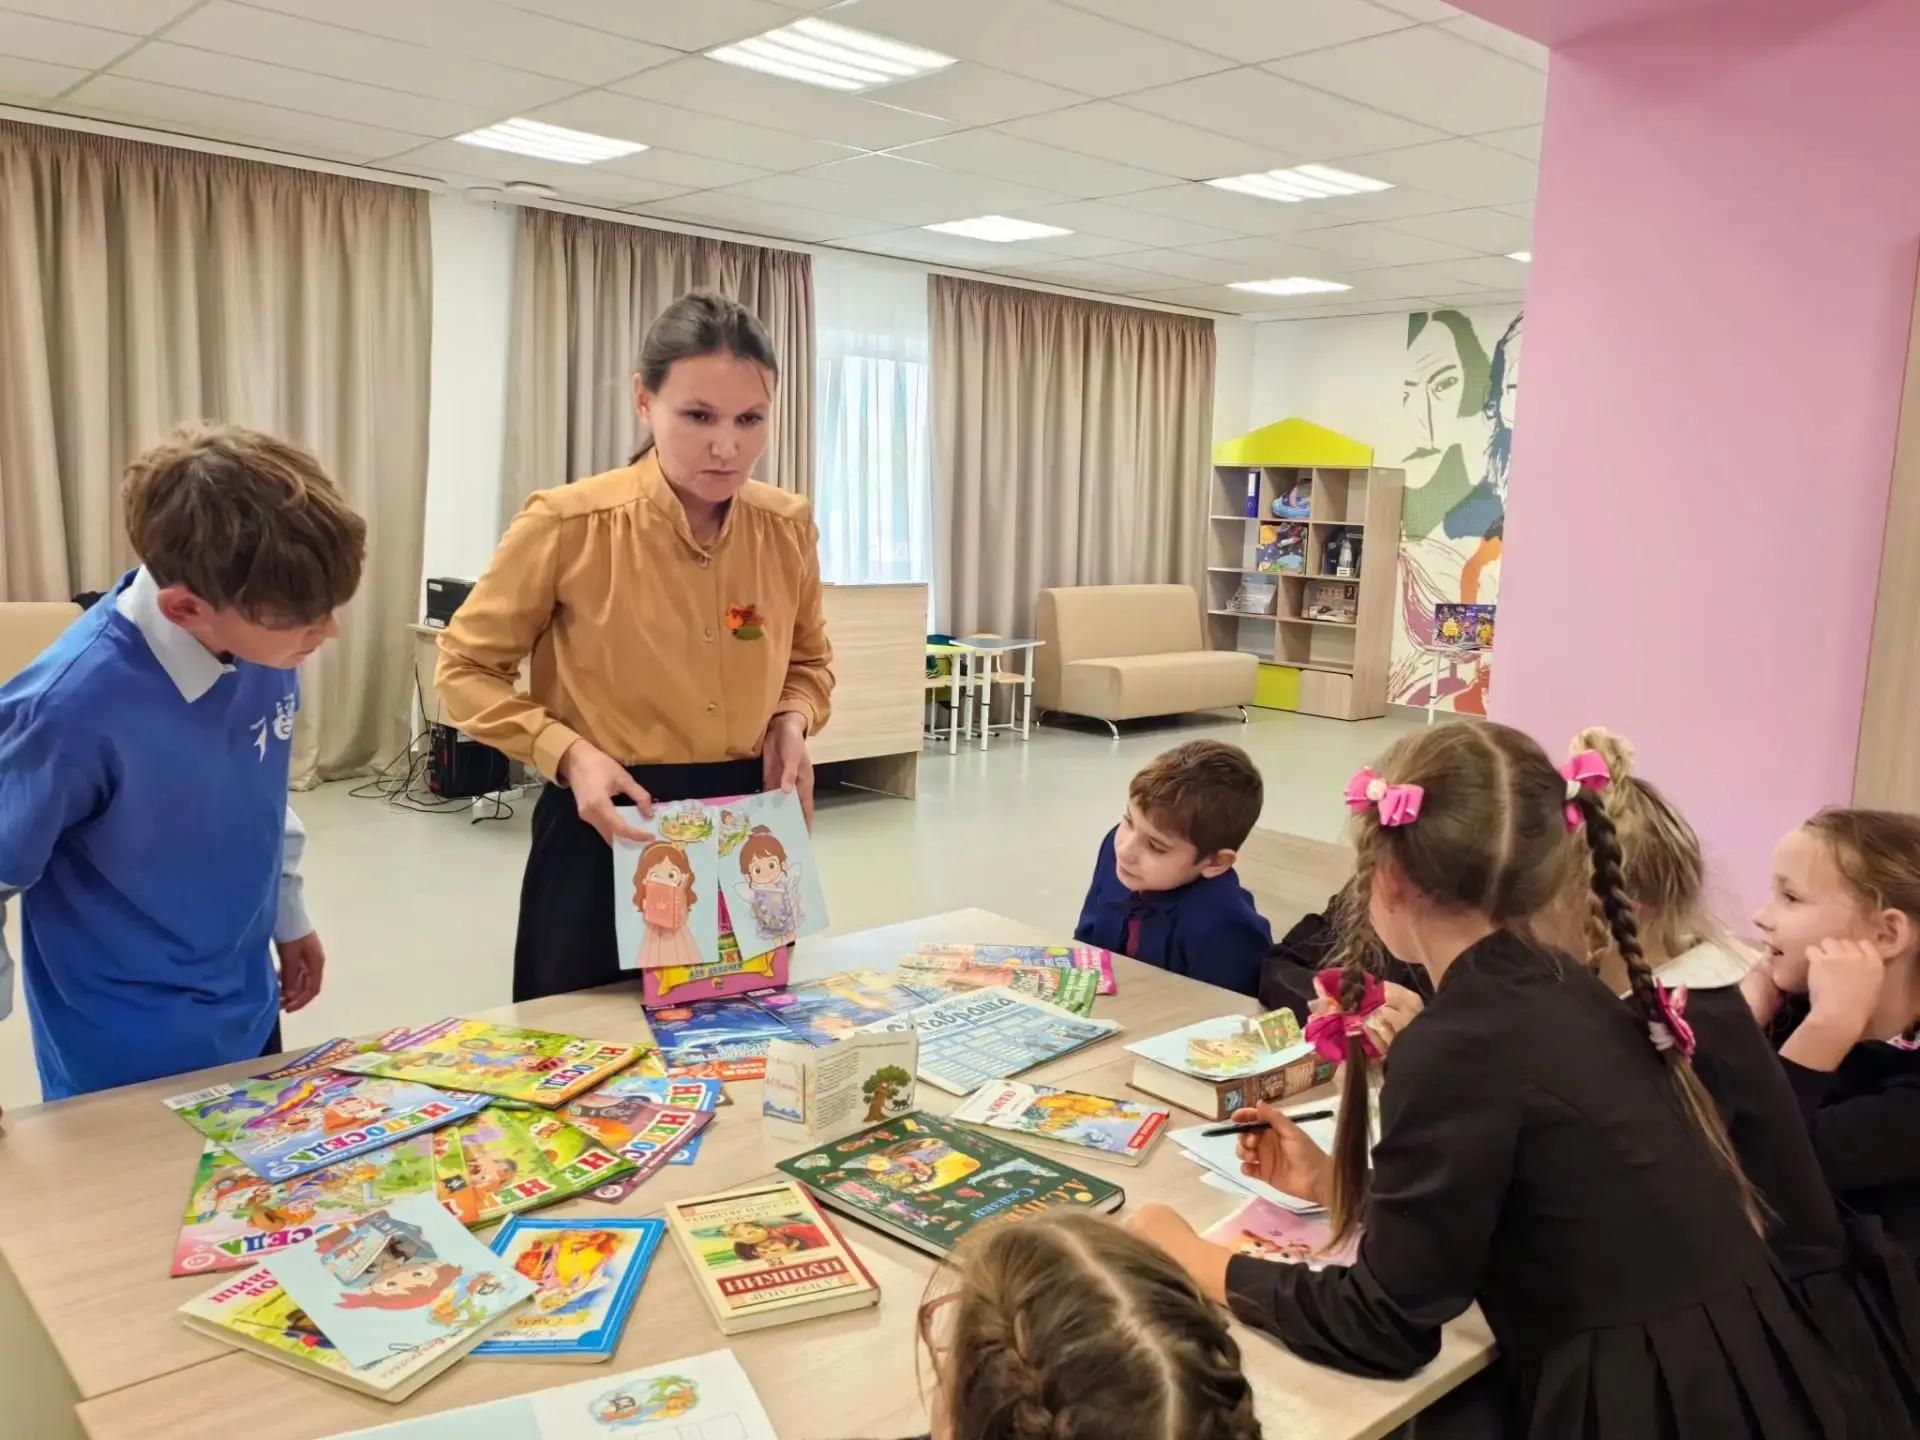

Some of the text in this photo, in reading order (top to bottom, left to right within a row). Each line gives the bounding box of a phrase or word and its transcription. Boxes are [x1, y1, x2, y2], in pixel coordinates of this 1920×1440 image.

[536, 1045, 630, 1091] НЕПОСЕДА
[286, 1102, 455, 1163] НЕПОСЕДА
[619, 1112, 692, 1160] НЕПОС
[723, 1259, 845, 1293] ПУШКИН
